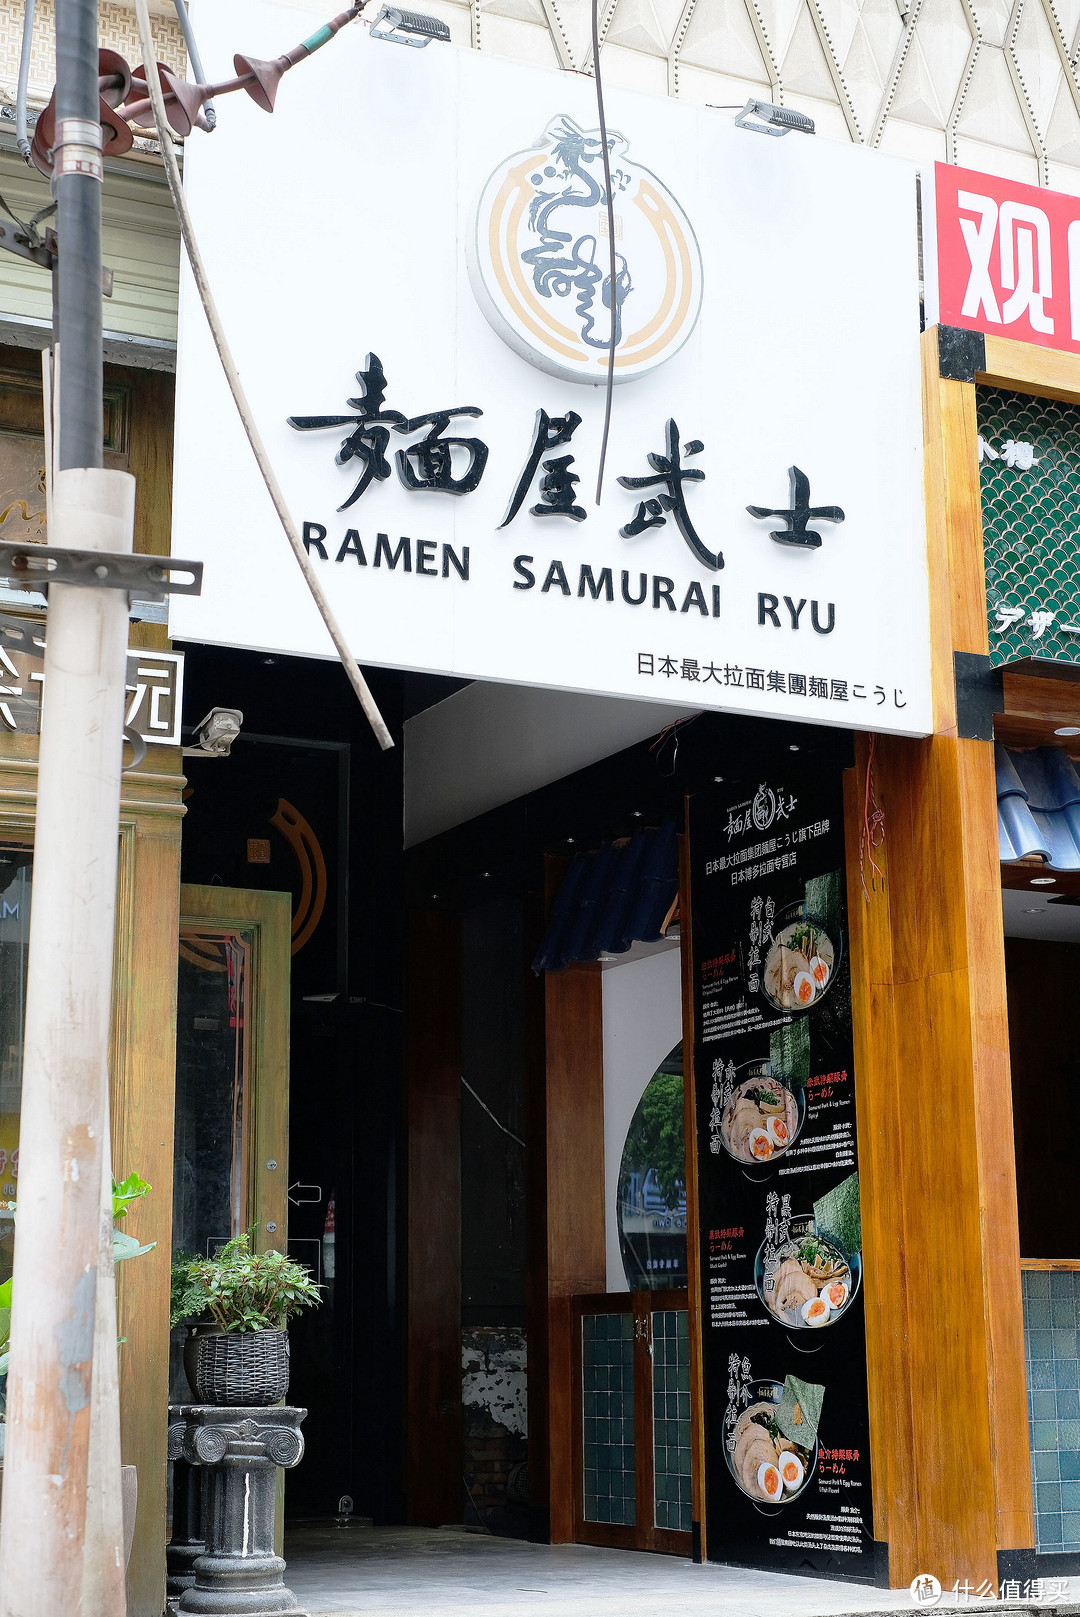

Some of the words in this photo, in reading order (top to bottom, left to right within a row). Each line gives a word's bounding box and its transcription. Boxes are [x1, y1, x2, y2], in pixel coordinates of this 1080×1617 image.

[302, 521, 470, 581] RAMEN
[513, 554, 721, 618] SAMURAI
[757, 592, 836, 635] RYU
[819, 1461, 846, 1474] らーめん
